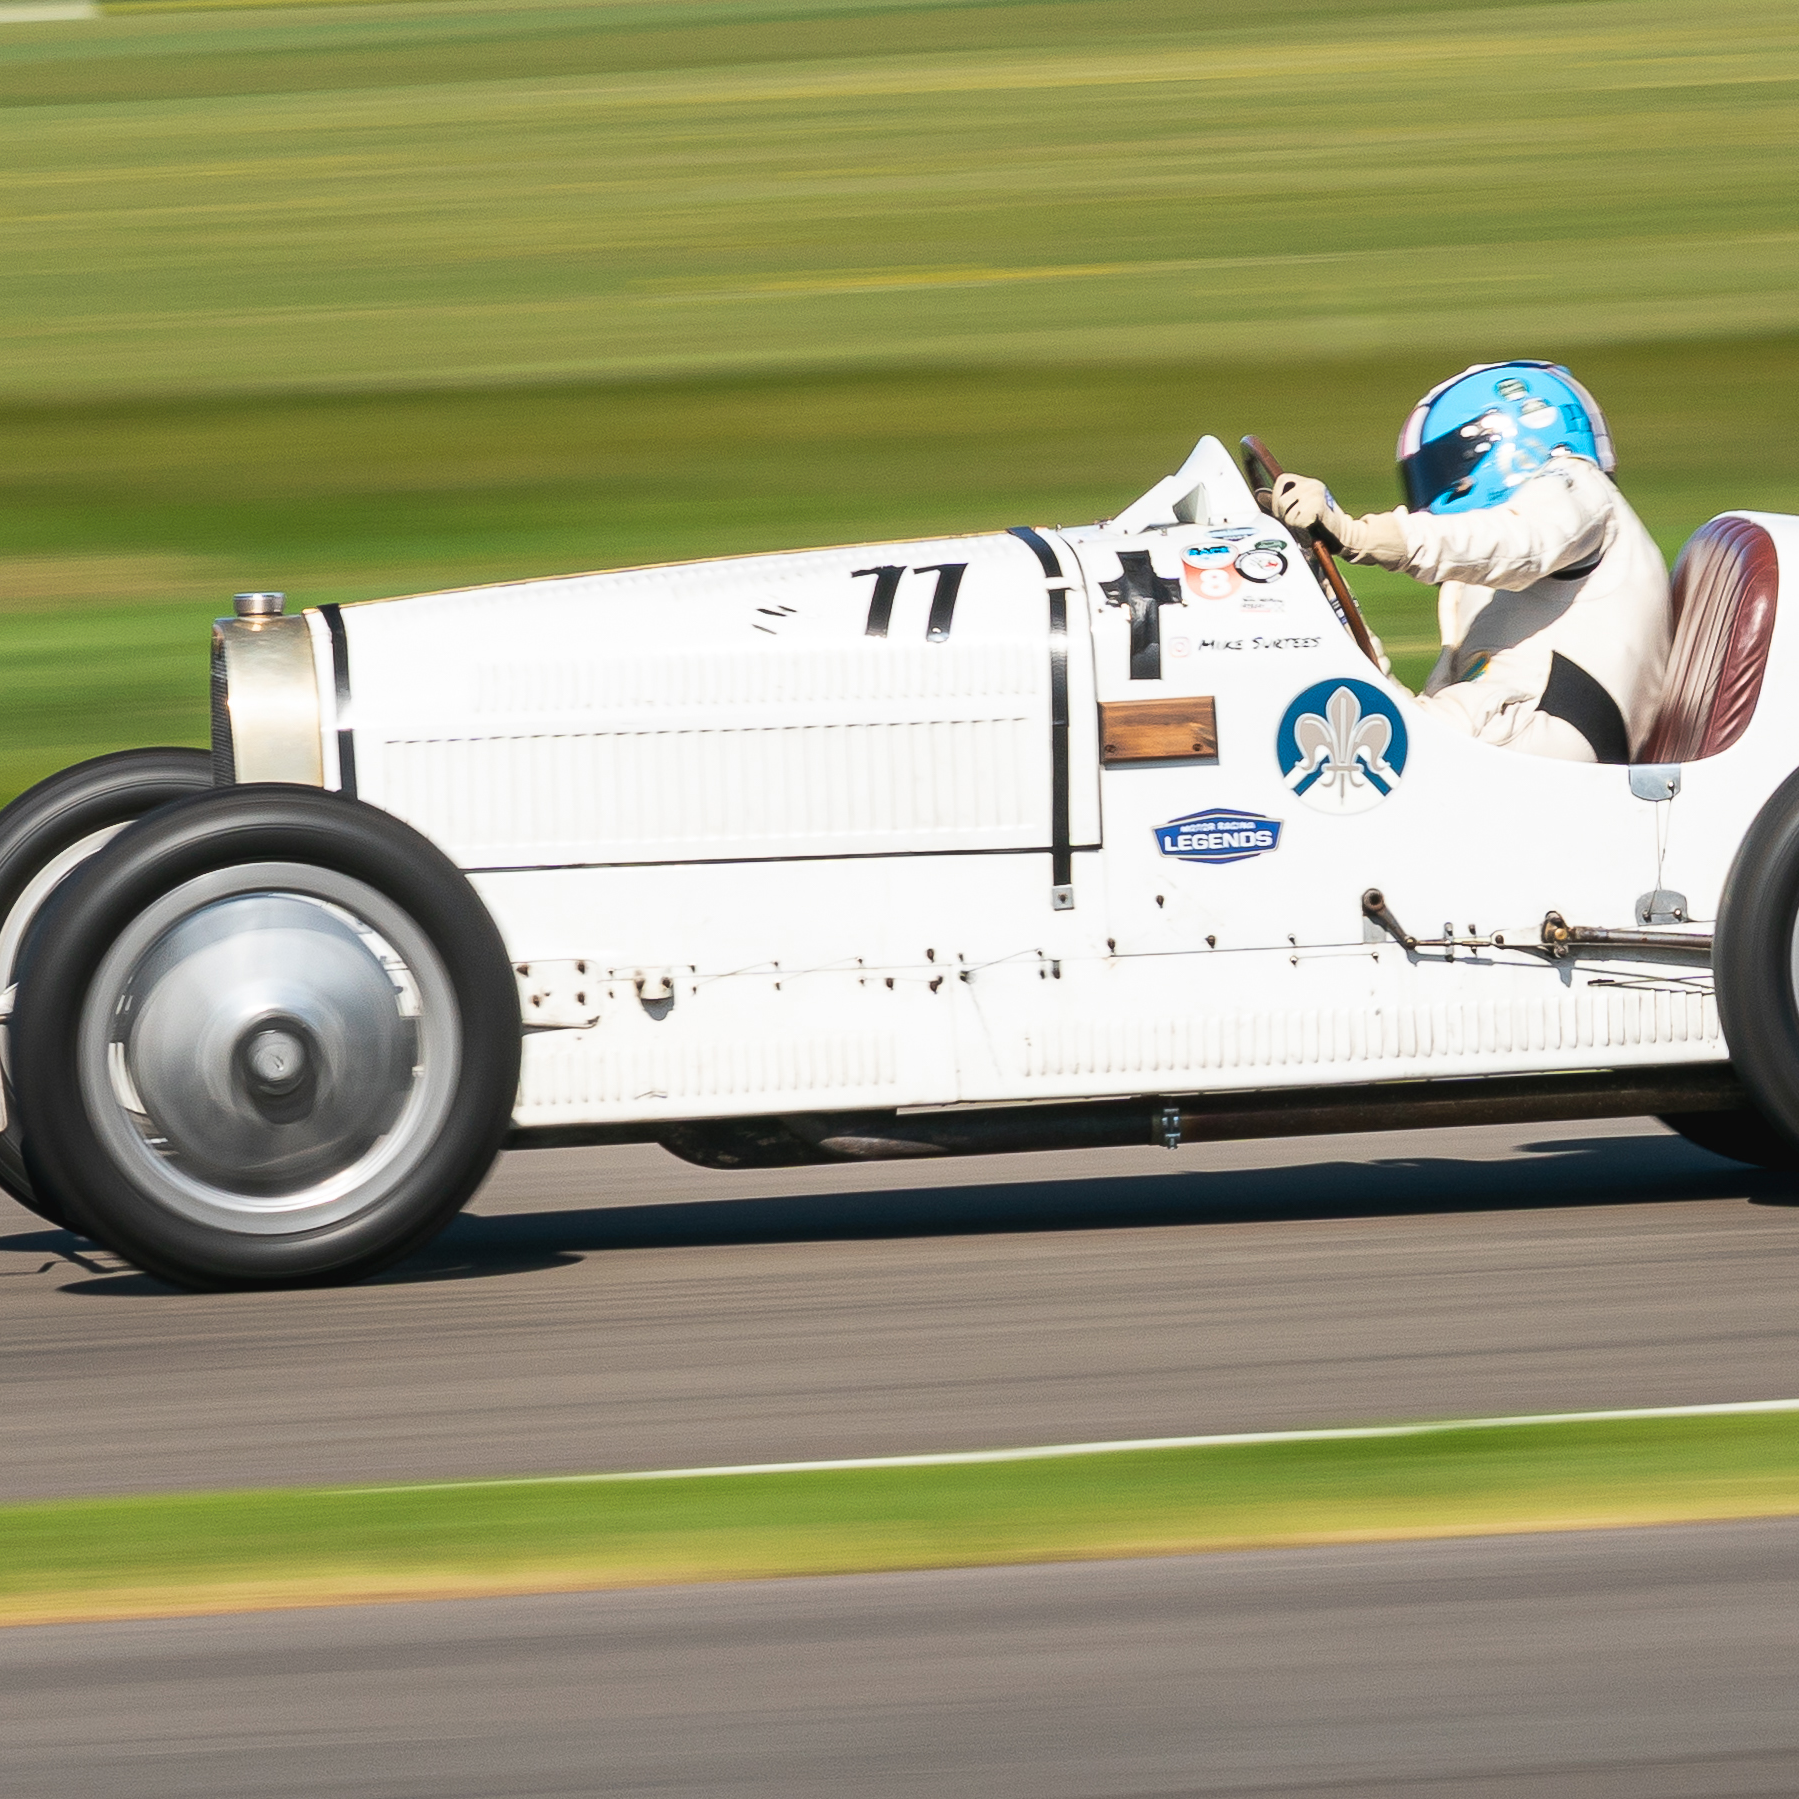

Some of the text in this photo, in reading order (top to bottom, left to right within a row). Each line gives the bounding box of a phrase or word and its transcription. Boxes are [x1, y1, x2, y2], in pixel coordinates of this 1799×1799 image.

[1200, 569, 1232, 598] 8
[850, 562, 969, 643] 11
[1198, 638, 1244, 650] MIKE
[1164, 830, 1273, 852] LEGENDS
